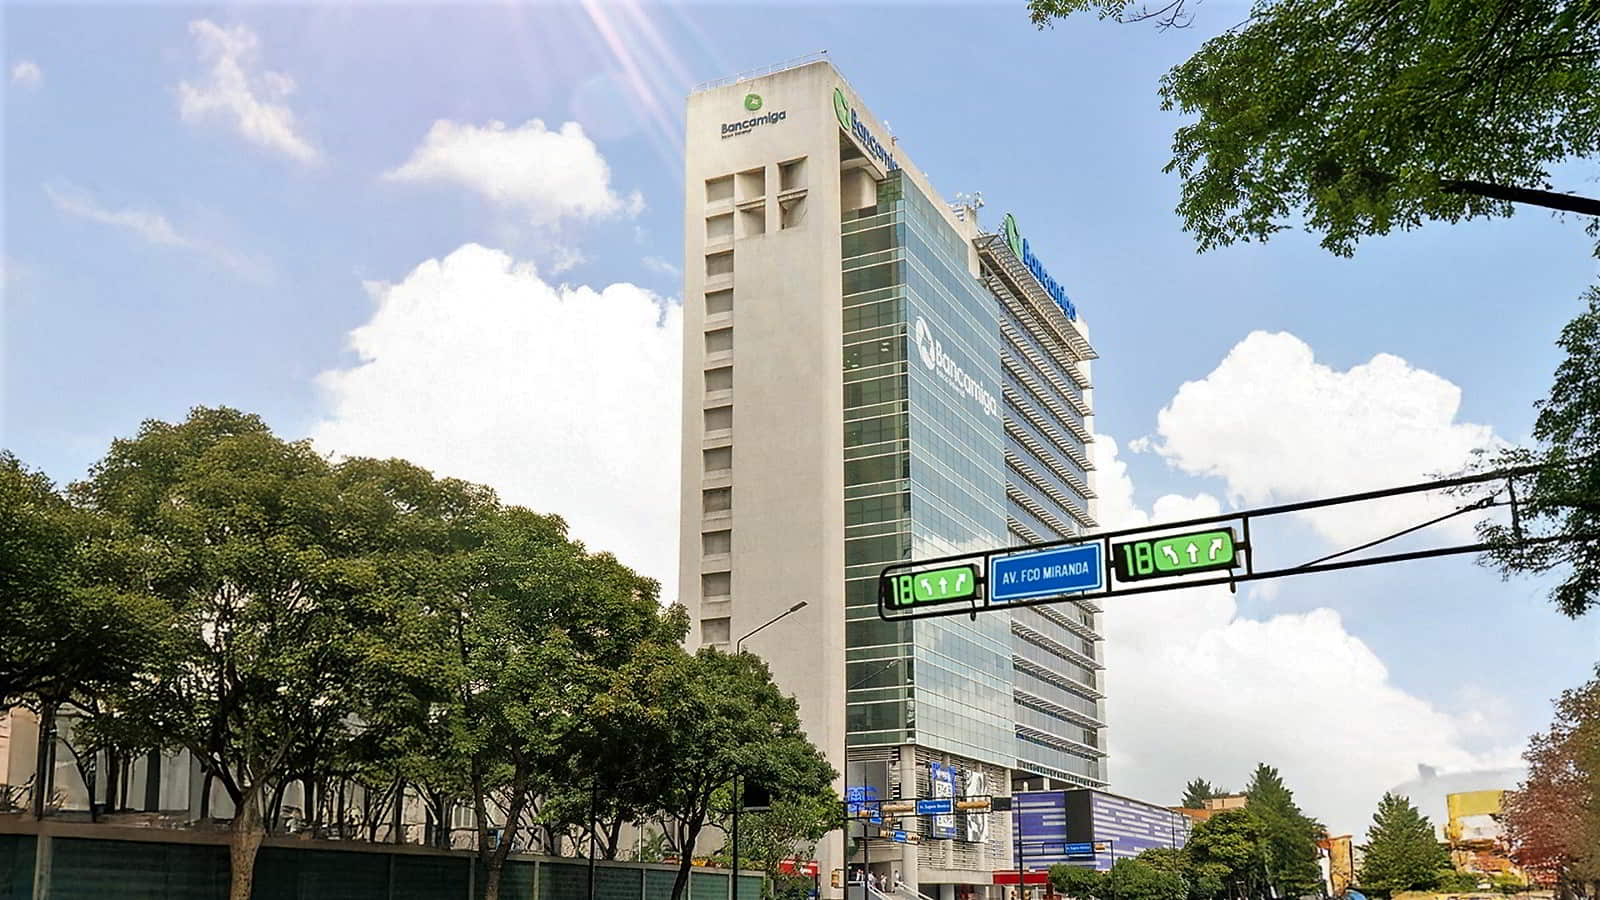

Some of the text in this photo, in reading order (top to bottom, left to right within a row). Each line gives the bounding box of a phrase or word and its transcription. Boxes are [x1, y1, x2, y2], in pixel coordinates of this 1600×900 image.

[721, 110, 786, 134] Bancamiga
[935, 339, 997, 416] Bancamiga
[1002, 561, 1090, 585] AV. FCO MIRANDA
[1123, 541, 1154, 576] 18
[891, 575, 914, 605] 18
